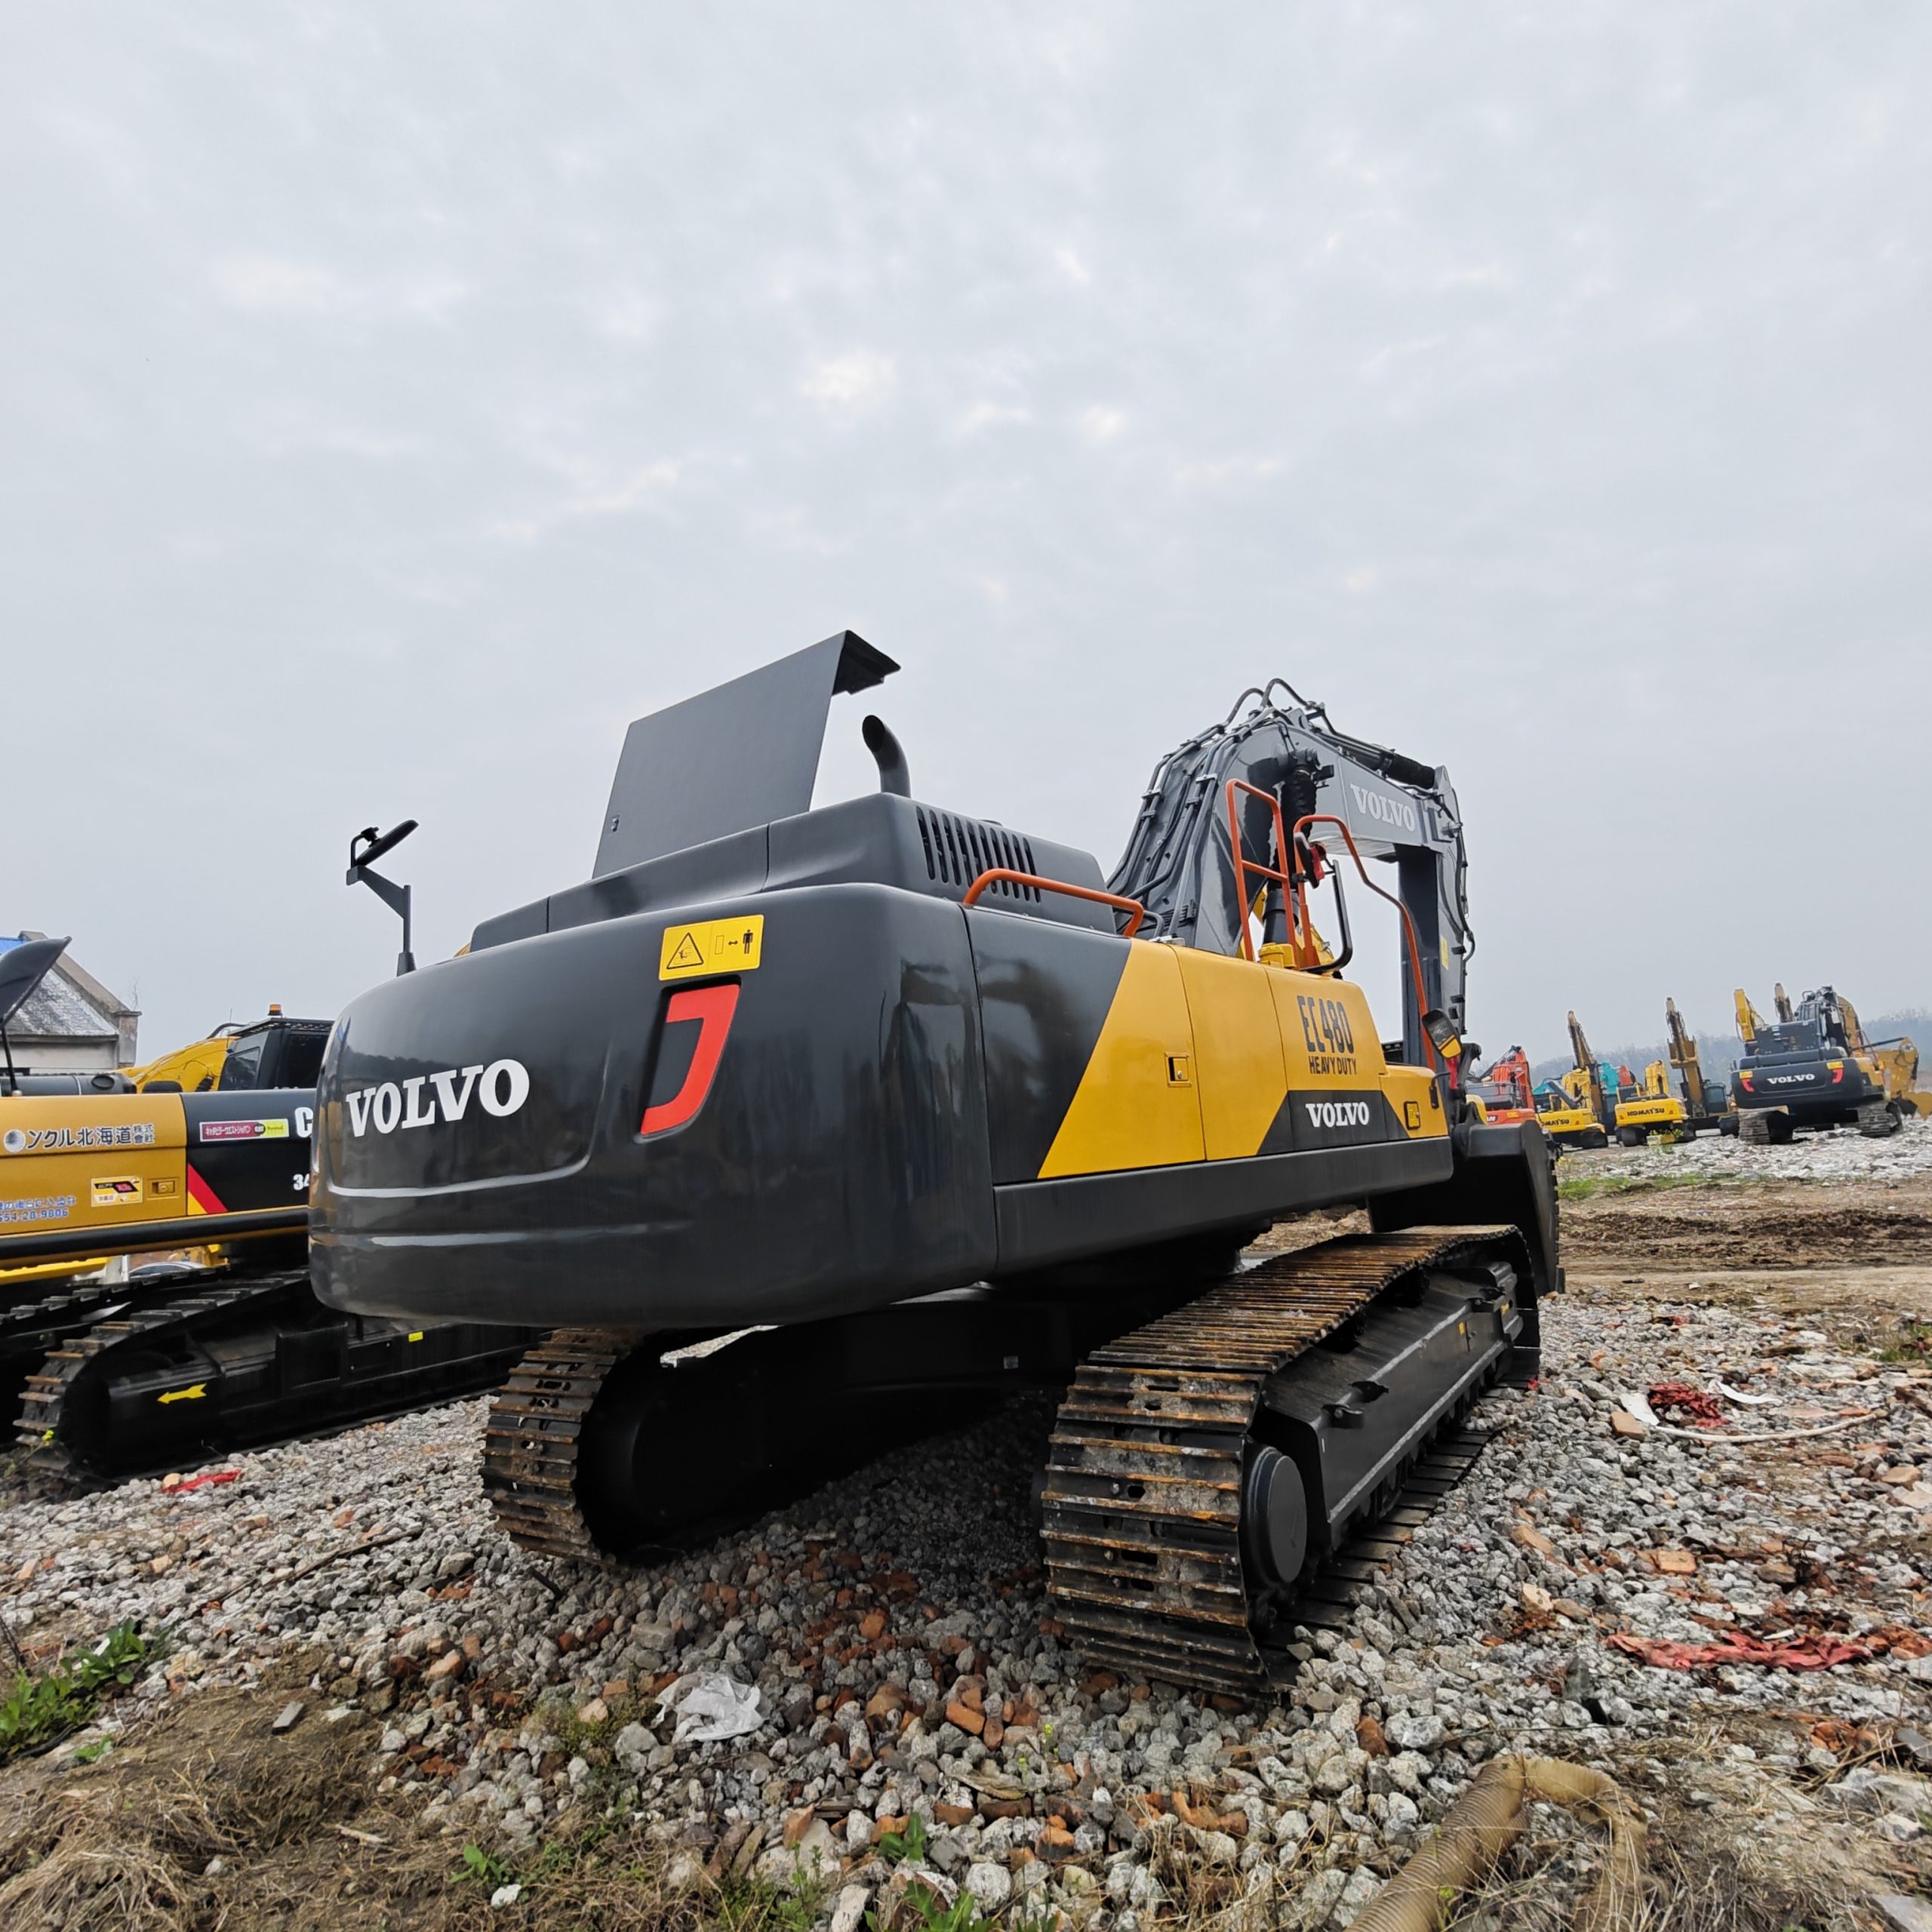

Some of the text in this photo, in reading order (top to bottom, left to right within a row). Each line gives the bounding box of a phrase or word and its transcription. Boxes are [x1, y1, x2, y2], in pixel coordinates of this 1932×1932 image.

[1349, 783, 1416, 832] VOLVO
[1297, 995, 1355, 1054] EC480
[1309, 1056, 1358, 1075] HEAVY DUTY
[1767, 1073, 1816, 1084] VOLVO
[346, 1059, 530, 1138] VOLVO
[1627, 1108, 1665, 1116] KOMATSU
[1306, 1101, 1370, 1128] VOLVO
